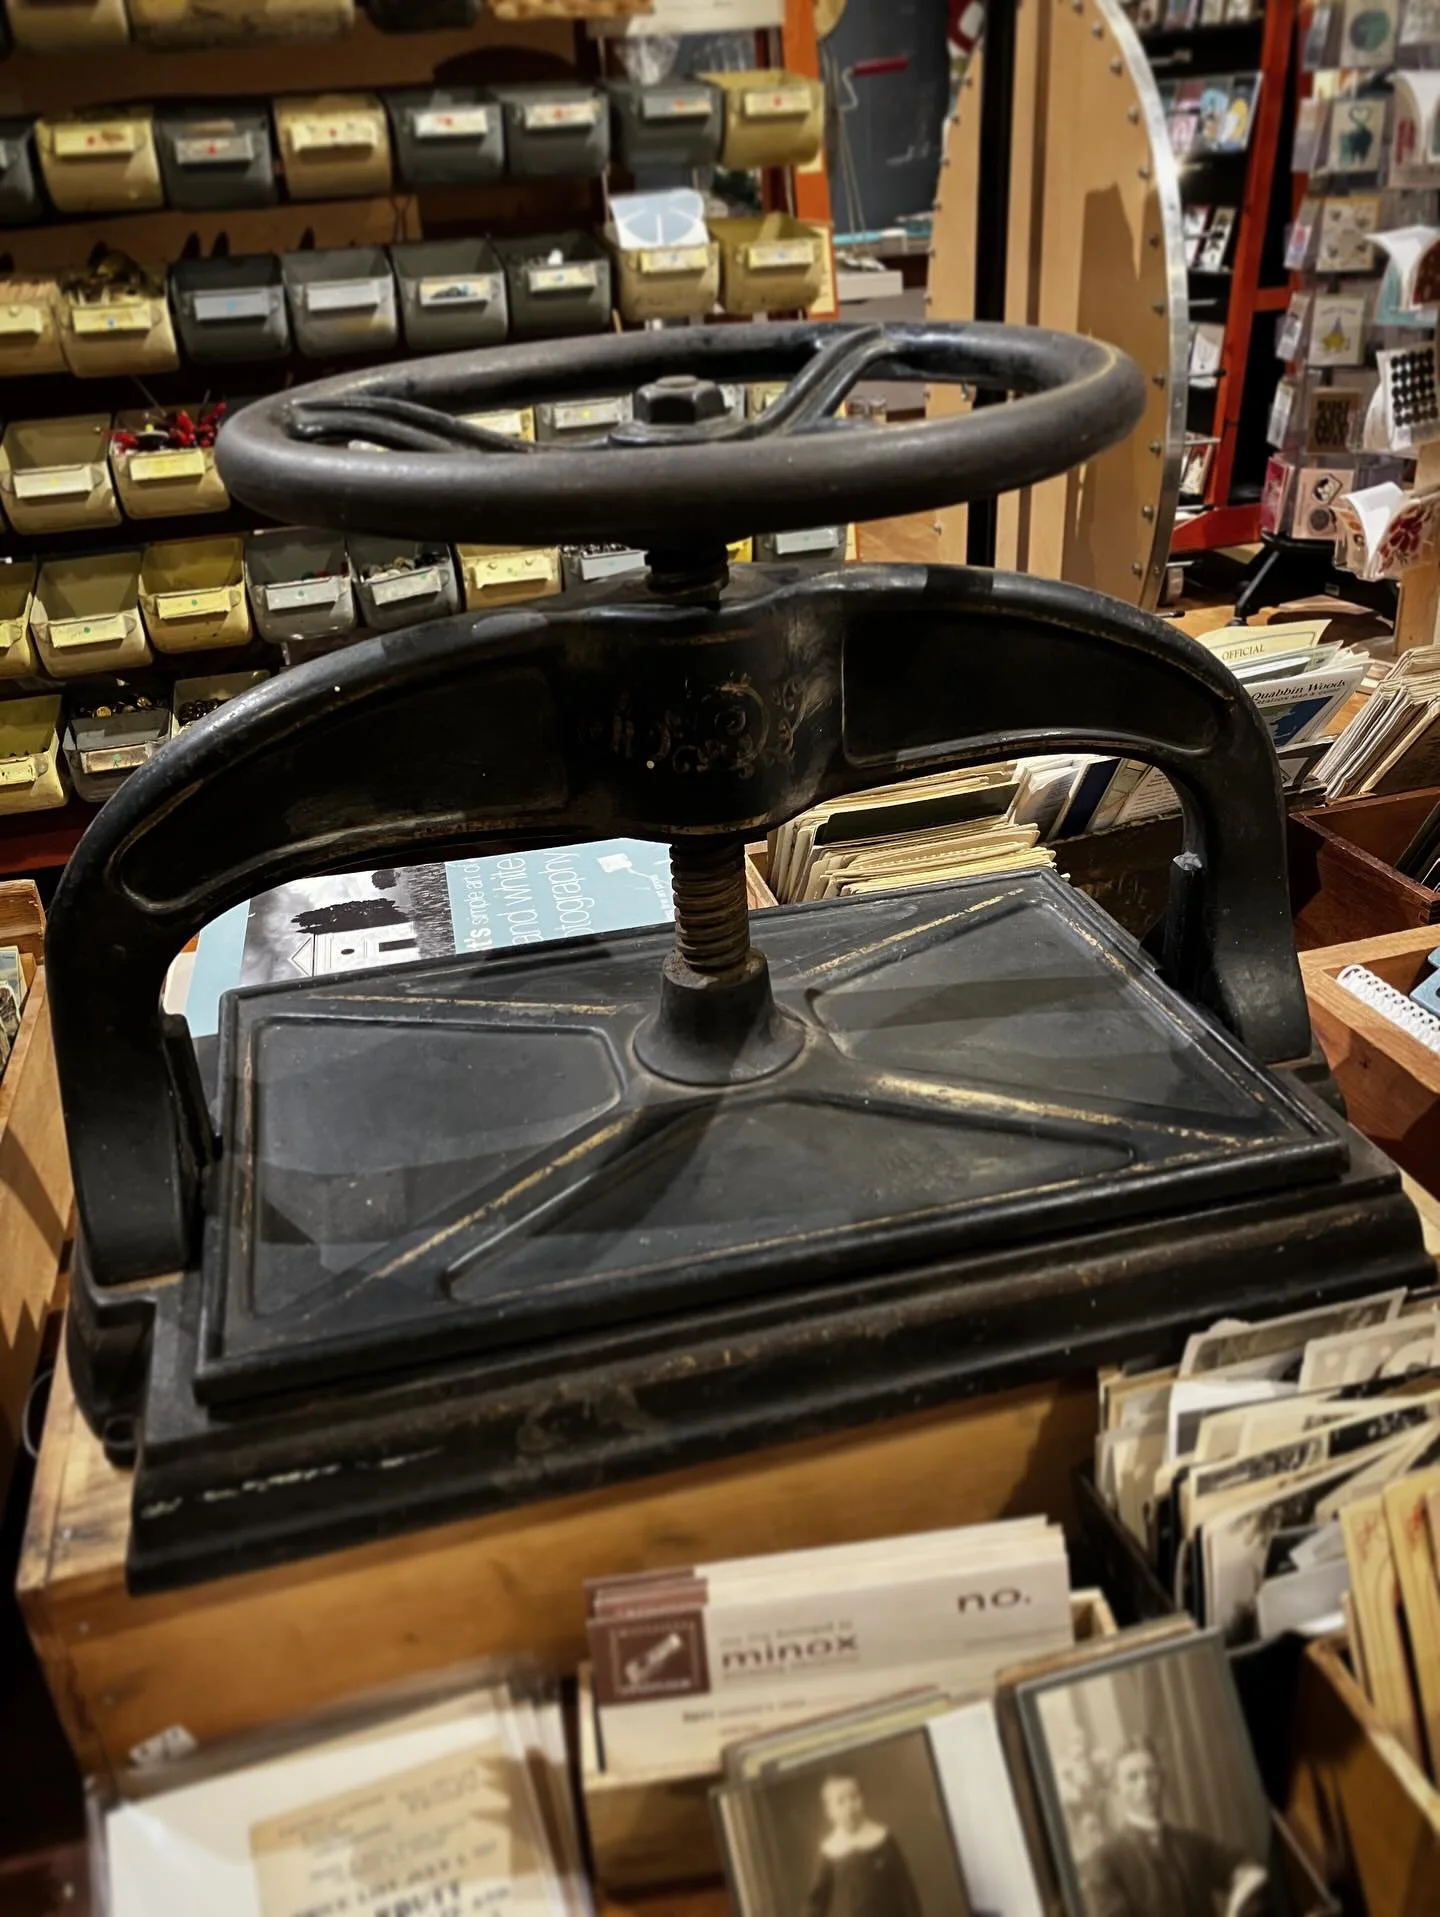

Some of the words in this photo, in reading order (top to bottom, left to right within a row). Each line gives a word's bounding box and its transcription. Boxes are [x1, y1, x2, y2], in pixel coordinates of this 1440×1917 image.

[1222, 643, 1264, 660] OFFICIAL
[1252, 686, 1303, 701] Quabbin
[1308, 679, 1345, 692] Woods
[464, 876, 484, 890] art
[489, 857, 534, 906] white
[464, 889, 491, 925] simple
[497, 908, 543, 946] and
[957, 1587, 1031, 1613] no.
[722, 1634, 858, 1668] minox
